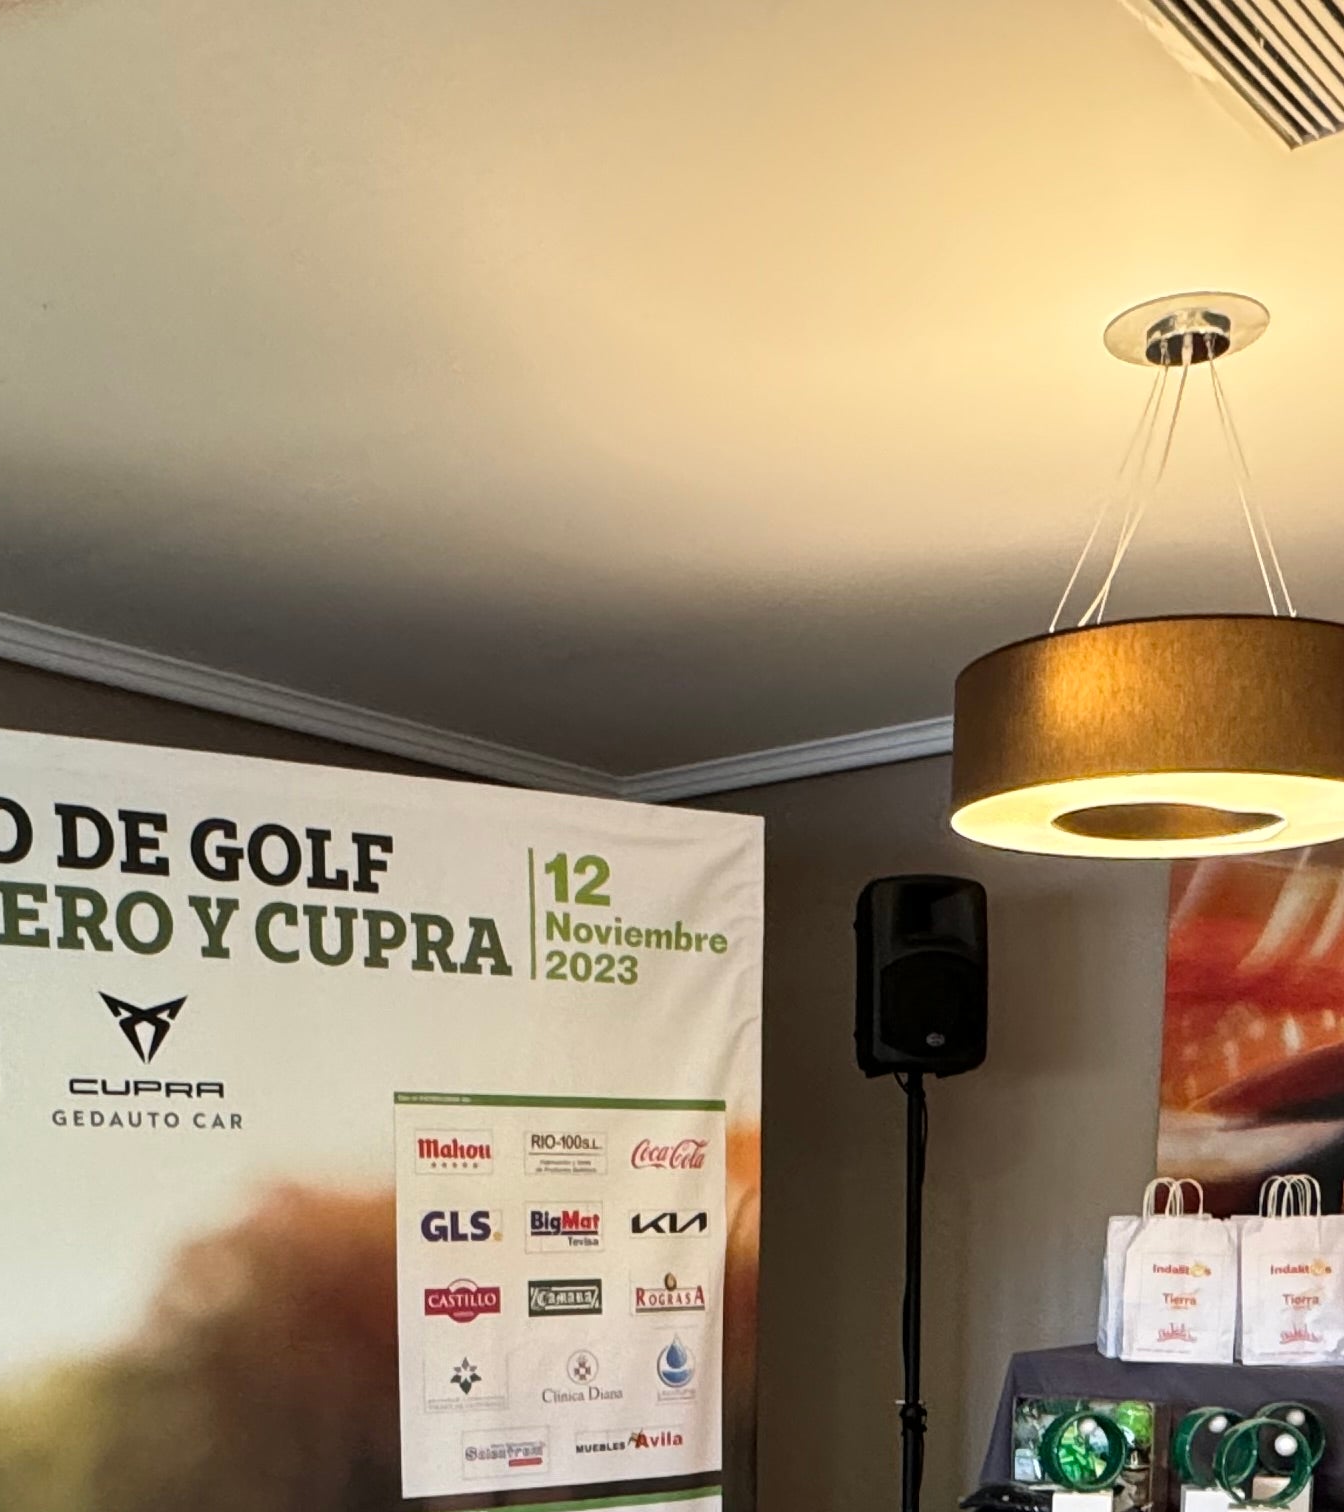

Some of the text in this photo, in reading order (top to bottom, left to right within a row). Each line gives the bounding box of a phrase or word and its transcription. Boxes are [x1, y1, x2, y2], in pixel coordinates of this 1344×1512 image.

[54, 803, 170, 876] DE
[190, 818, 394, 893] GOLF
[544, 852, 611, 907] 12
[188, 895, 239, 959] Y
[255, 902, 513, 976] CUPRA
[545, 911, 728, 954] Noviembre
[545, 950, 639, 985] 2023
[69, 1078, 225, 1099] CUPRA
[52, 1110, 244, 1130] GEDAUTO CAR
[417, 1138, 492, 1160] Mahou
[530, 1210, 600, 1236] BigMat
[428, 1293, 497, 1308] CASTILLO
[636, 1285, 705, 1307] ROGRASA
[1162, 1292, 1197, 1306] Tierra
[589, 1386, 624, 1401] Diana
[576, 1441, 625, 1454] MUEBLES
